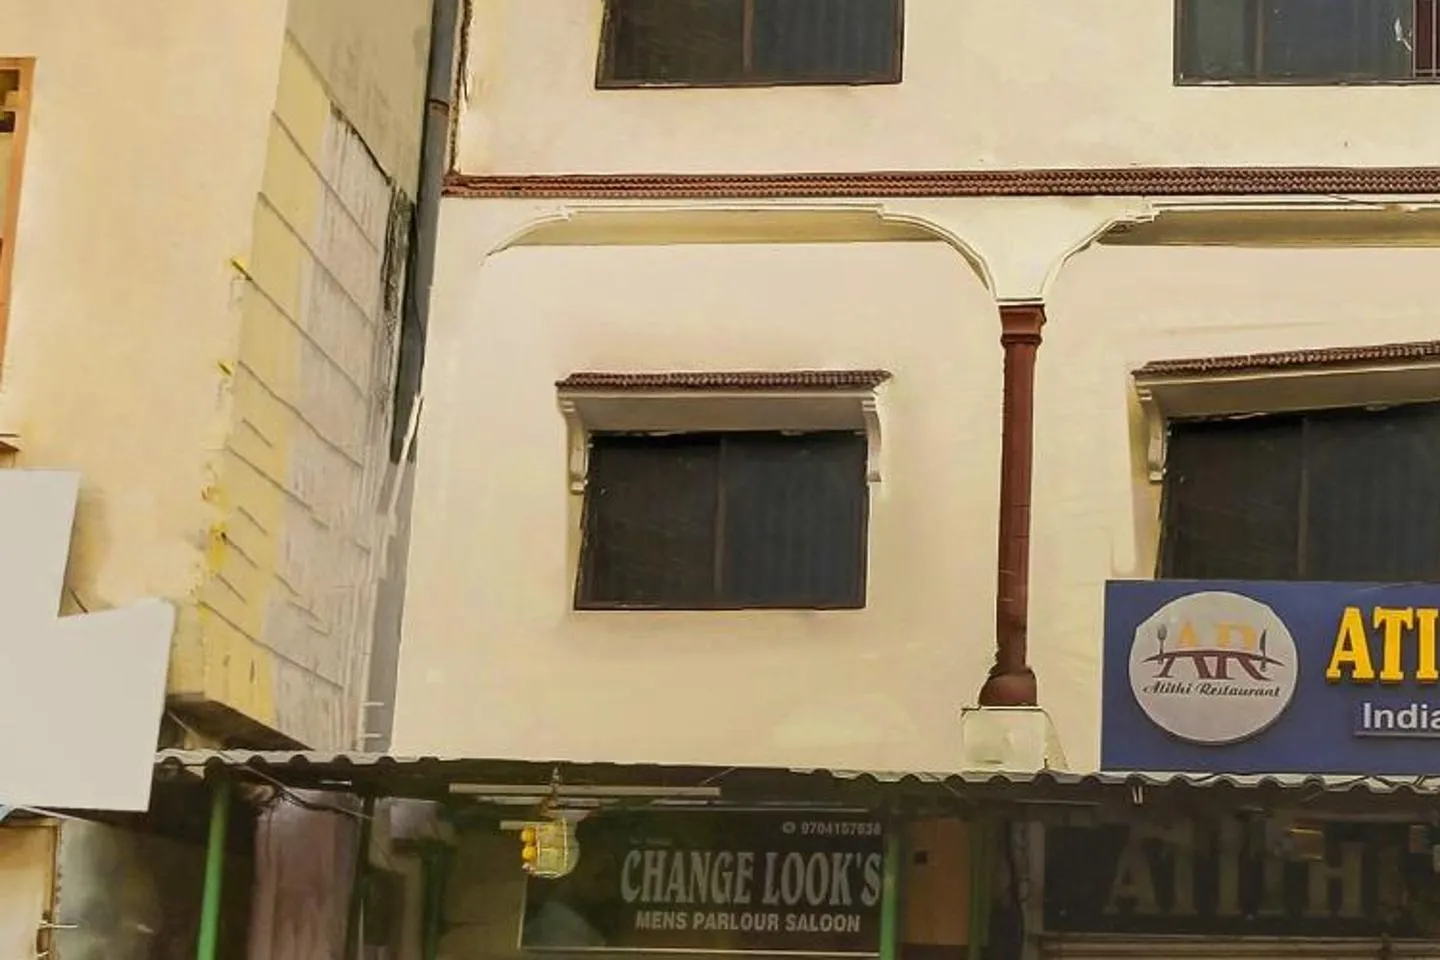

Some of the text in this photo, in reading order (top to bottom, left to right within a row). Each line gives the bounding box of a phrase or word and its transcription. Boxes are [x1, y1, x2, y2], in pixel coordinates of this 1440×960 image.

[1143, 681, 1281, 697] Atithi Restaurant
[621, 850, 882, 907] CHANGE LOOK'S
[635, 910, 862, 933] MENS PARLOUR SALOON
